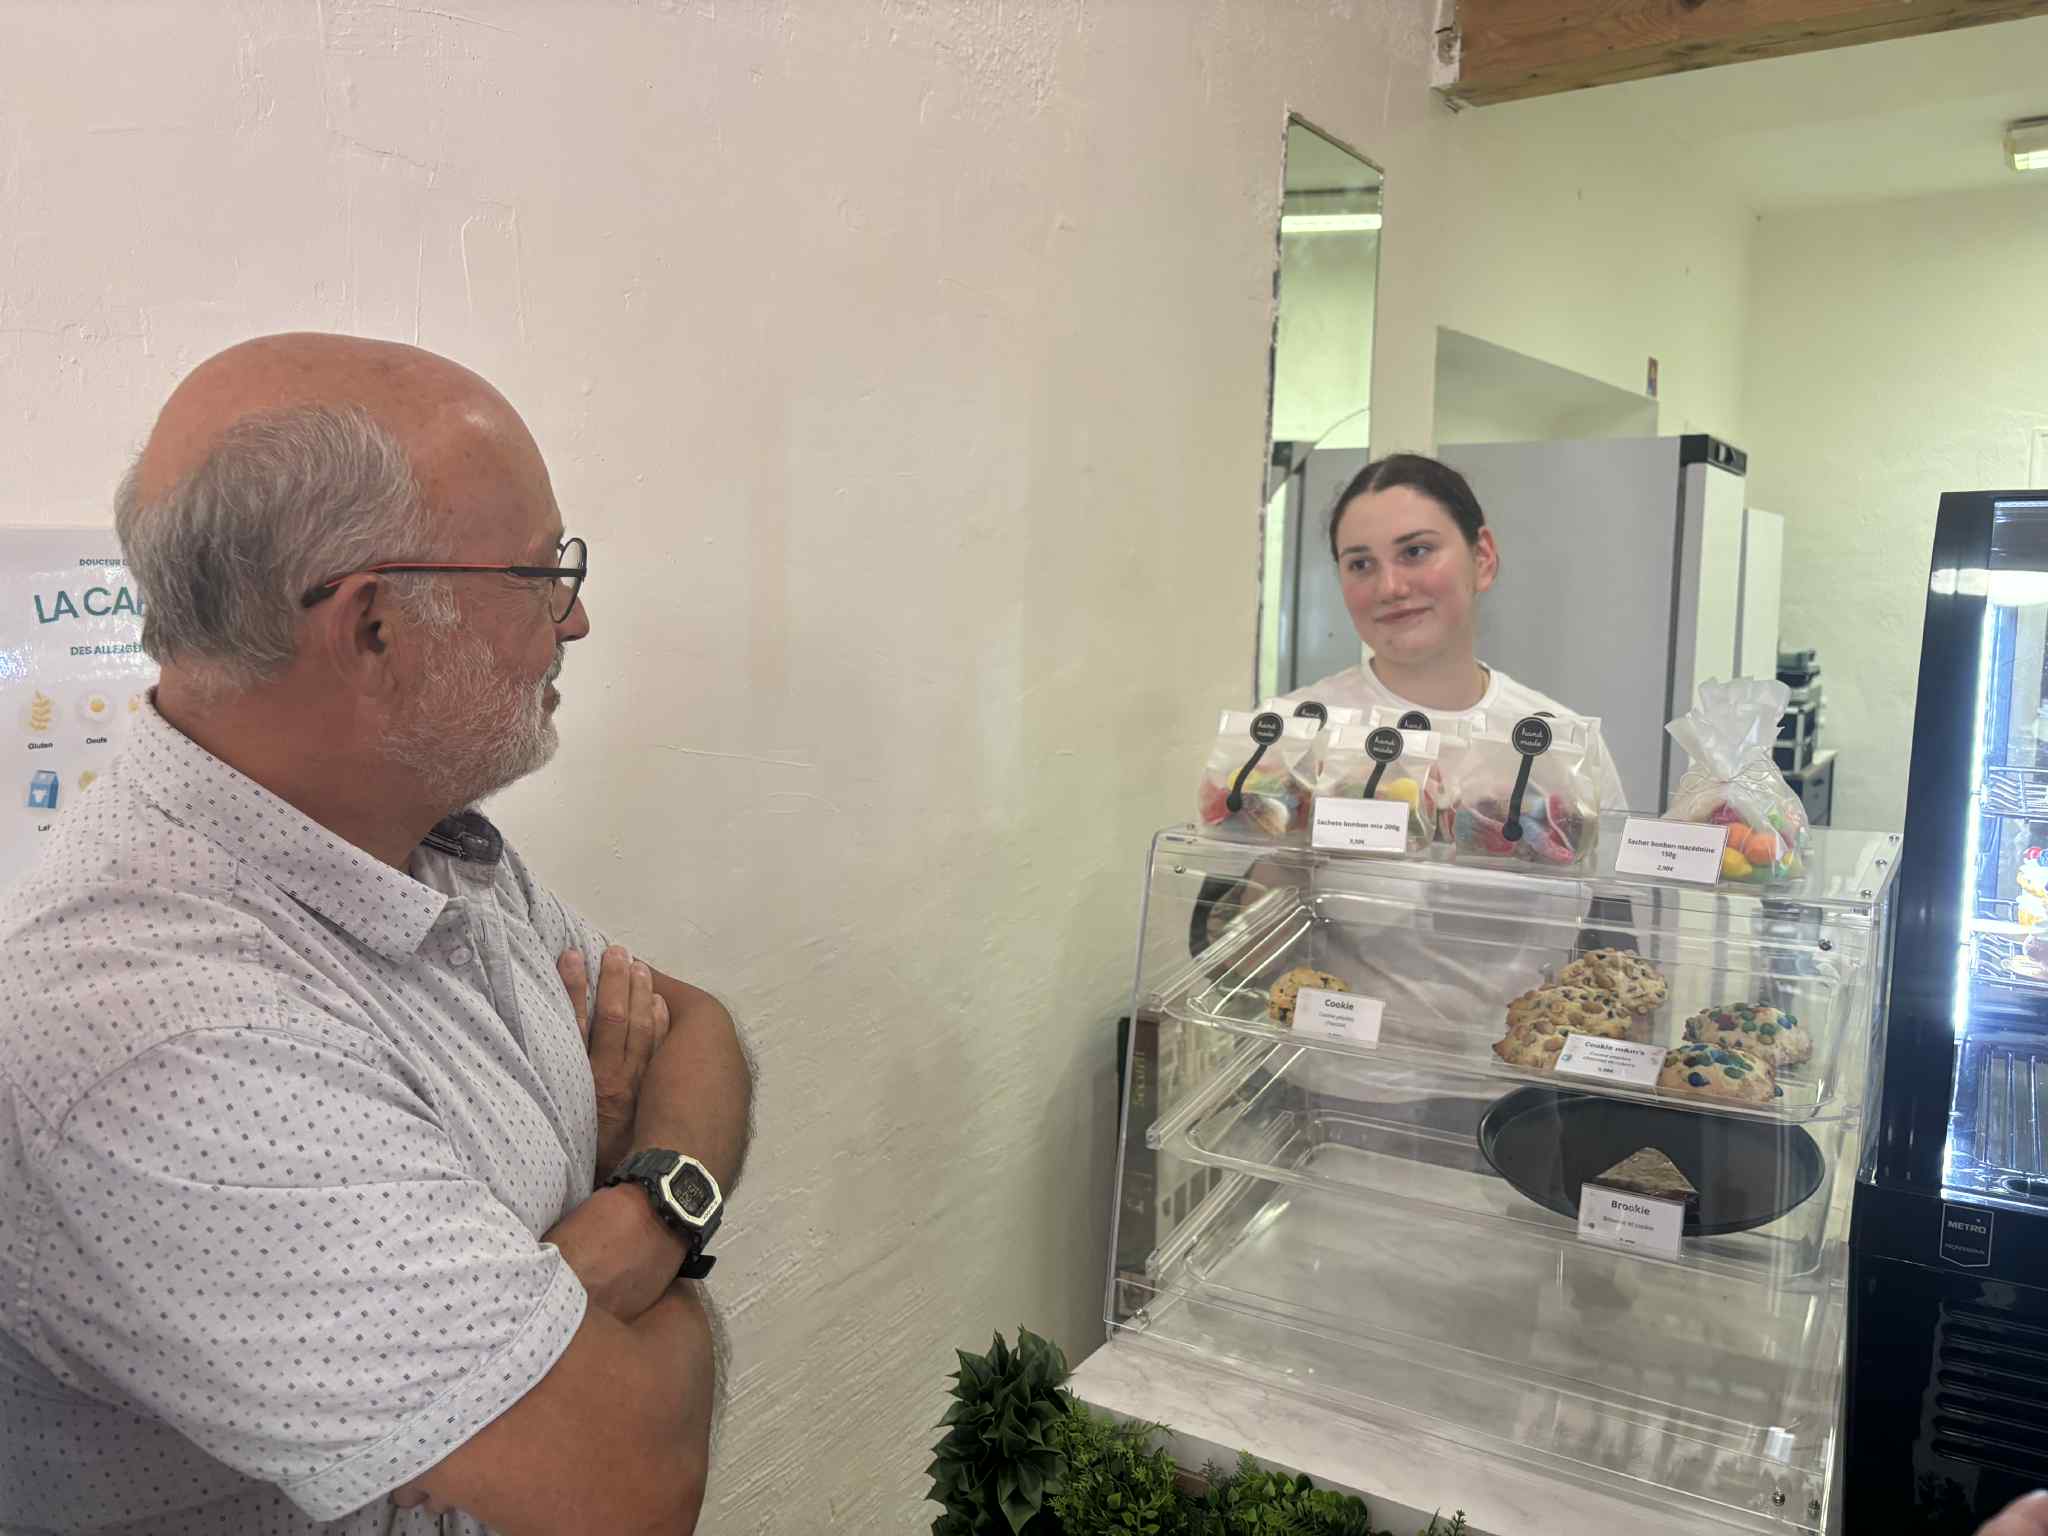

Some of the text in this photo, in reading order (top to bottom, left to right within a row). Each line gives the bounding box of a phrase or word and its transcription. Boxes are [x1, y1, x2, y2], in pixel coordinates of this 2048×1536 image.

[34, 590, 80, 624] LA
[70, 646, 92, 657] DES
[1521, 726, 1544, 738] hand
[27, 742, 53, 750] Gluten
[1324, 999, 1354, 1011] Cookie
[1584, 1041, 1613, 1050] Cookie
[1611, 1200, 1651, 1216] Brookie
[1948, 1220, 1987, 1234] METRO
